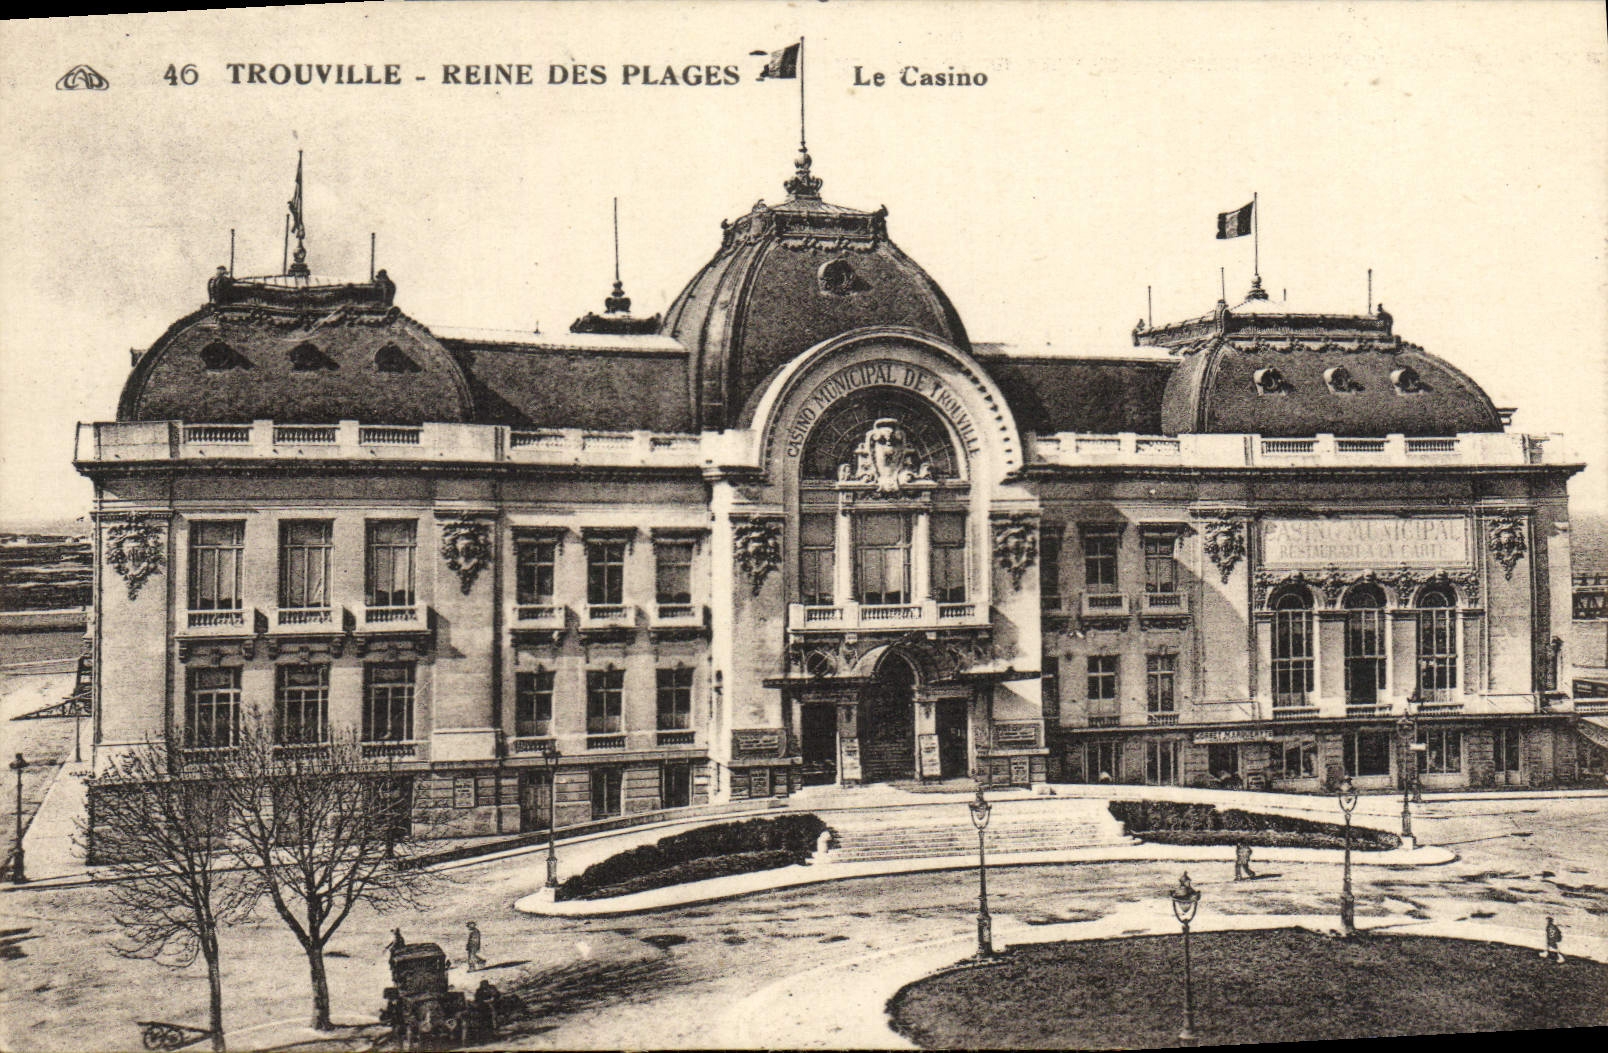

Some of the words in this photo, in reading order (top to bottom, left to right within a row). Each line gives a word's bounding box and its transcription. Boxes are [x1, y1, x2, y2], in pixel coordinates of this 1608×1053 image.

[787, 407, 816, 458] CASINO
[814, 363, 897, 410] MUNICIPAL
[903, 368, 929, 392] DE
[929, 382, 981, 456] TROUVILLE
[1346, 518, 1461, 541] MUNICIPAL
